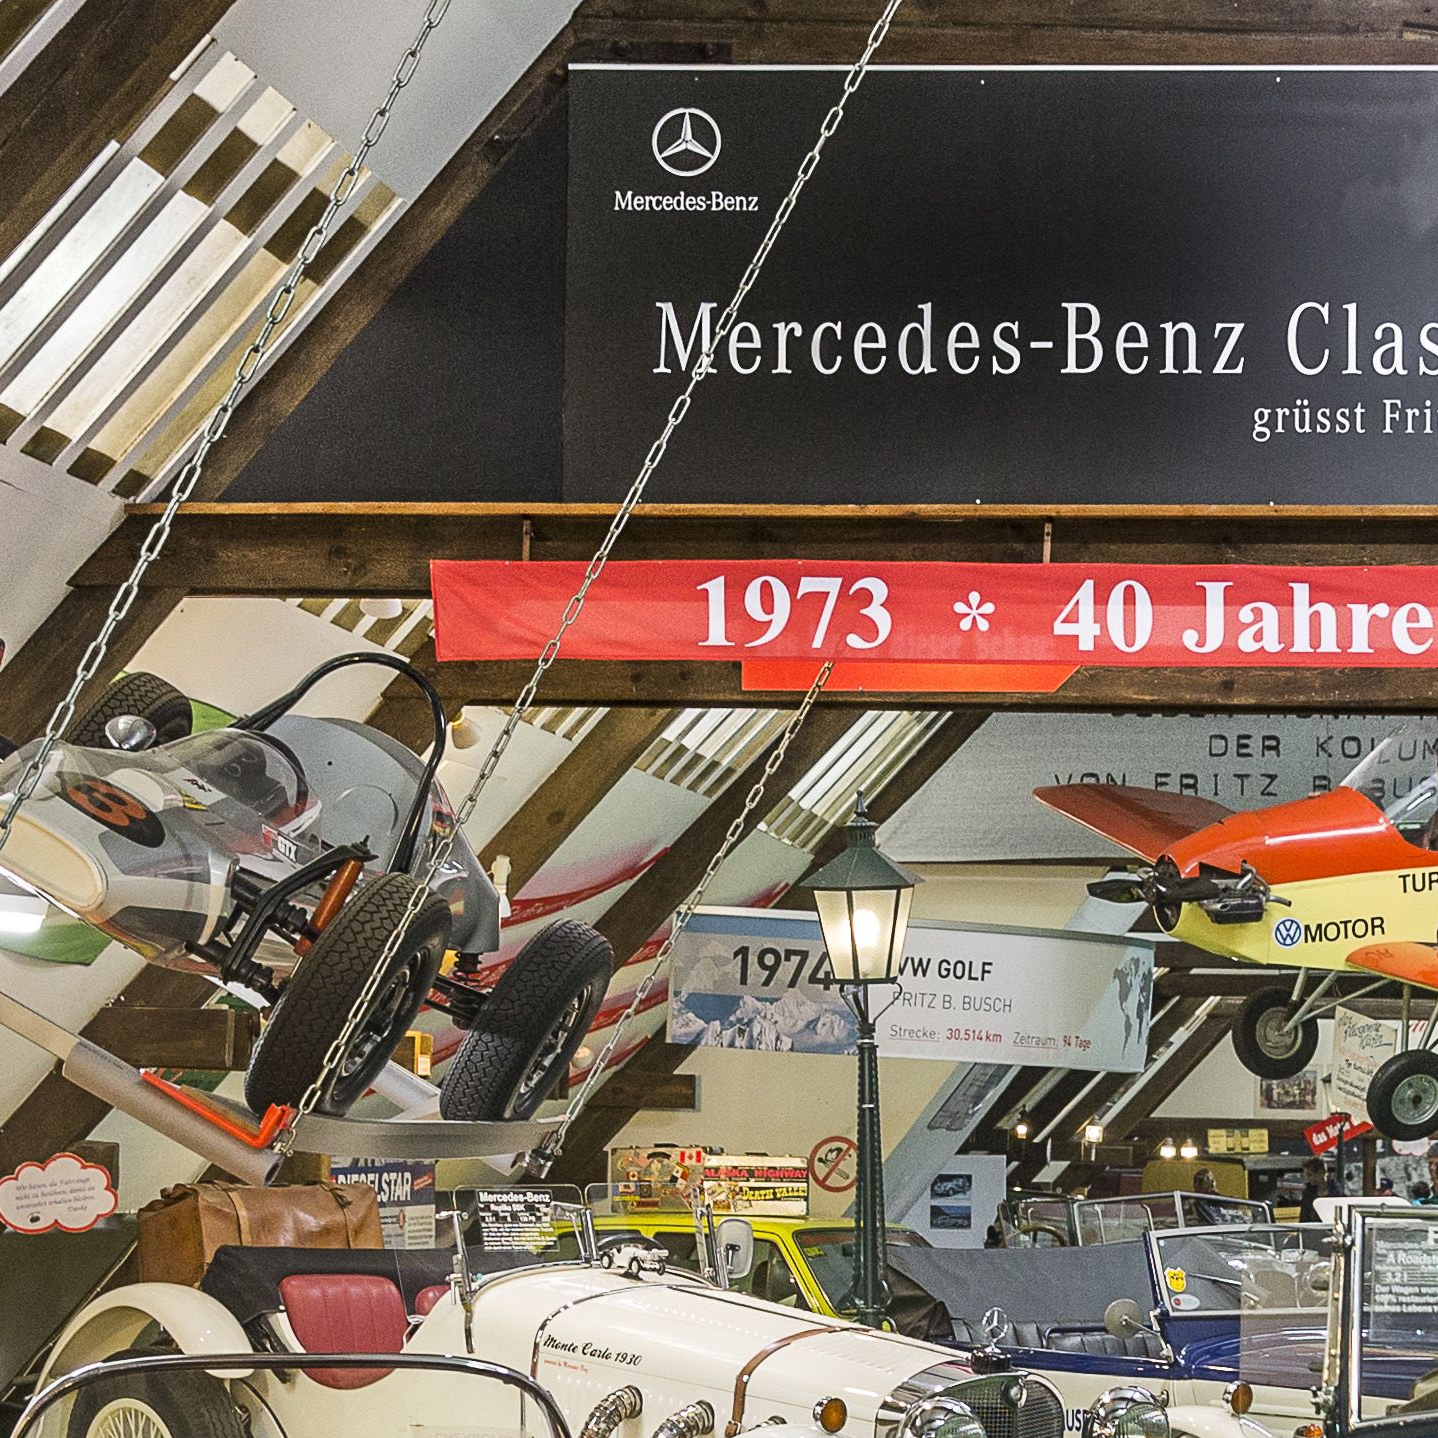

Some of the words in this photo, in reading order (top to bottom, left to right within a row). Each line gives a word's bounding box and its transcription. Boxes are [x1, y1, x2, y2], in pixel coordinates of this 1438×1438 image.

[613, 190, 759, 213] Mercedes-Benz
[652, 300, 1247, 377] Mercedes-Benz
[1252, 399, 1367, 442] grüsst
[696, 575, 893, 650] 1973
[1053, 579, 1154, 654] 40
[1181, 579, 1436, 656] Jahre
[1209, 734, 1281, 758] DER
[1155, 774, 1279, 797] FRITZ
[1304, 916, 1386, 944] MOTOR
[732, 945, 834, 992] 1974
[937, 959, 994, 982] GOLF
[892, 990, 938, 1010] FRITZ
[942, 994, 958, 1010] B.
[962, 996, 1014, 1014] BUSCH
[890, 1024, 941, 1042] Strecke:
[946, 1026, 983, 1044] 30.514
[984, 1030, 1003, 1044] km
[754, 1168, 809, 1179] HIGHWAY
[479, 1191, 551, 1203] Mercedes-Benz
[742, 1186, 774, 1201] DEATH
[542, 1334, 579, 1354] Monte
[581, 1342, 614, 1361] Carlo
[613, 1352, 644, 1367] 1930
